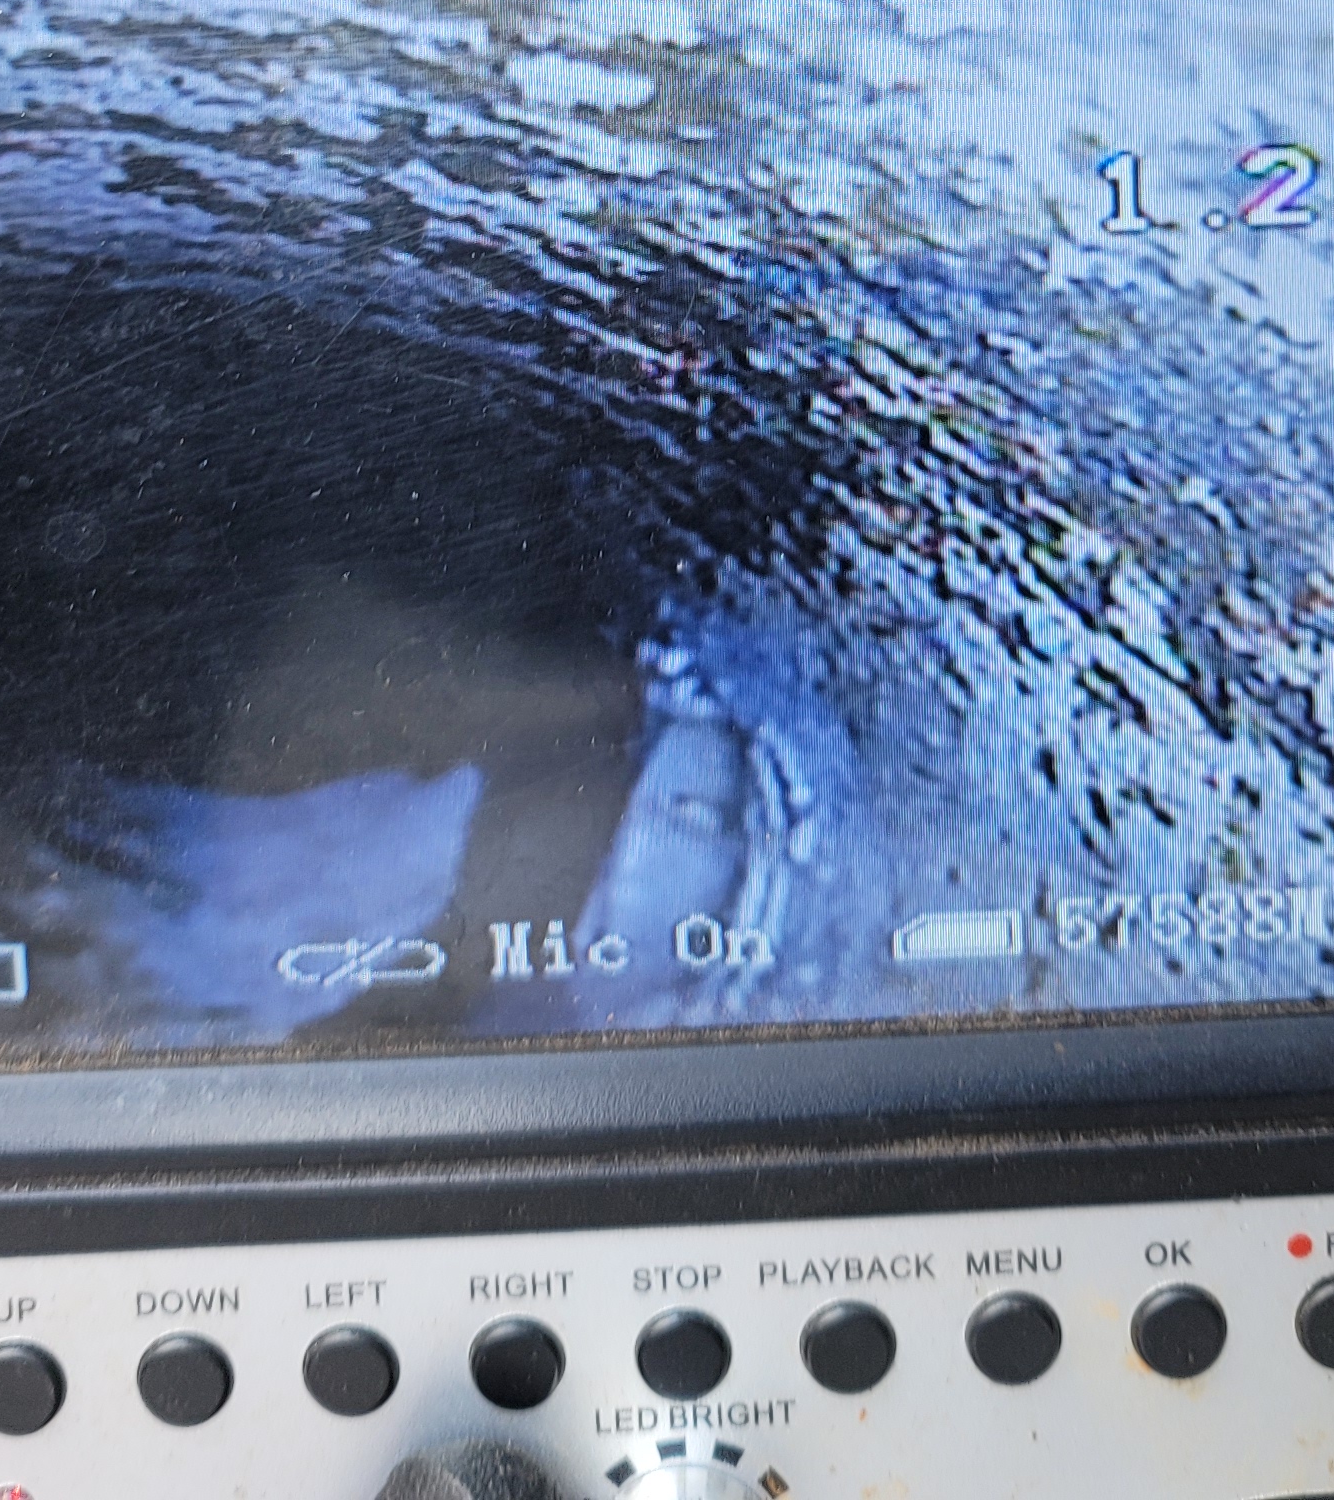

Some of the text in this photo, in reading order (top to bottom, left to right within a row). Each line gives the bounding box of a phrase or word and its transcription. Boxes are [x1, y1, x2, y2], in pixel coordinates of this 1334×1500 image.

[1095, 145, 1320, 234] 1.2
[489, 912, 775, 980] Mic On
[967, 1247, 1063, 1276] MENU
[1144, 1240, 1192, 1267] OK
[632, 1265, 723, 1292] STOP
[758, 1253, 937, 1287] PLAYBACK
[304, 1280, 387, 1309] LEFT
[468, 1271, 574, 1299] RIGHT
[135, 1287, 240, 1316] DOWN
[595, 1400, 796, 1434] LED BRIGHT
